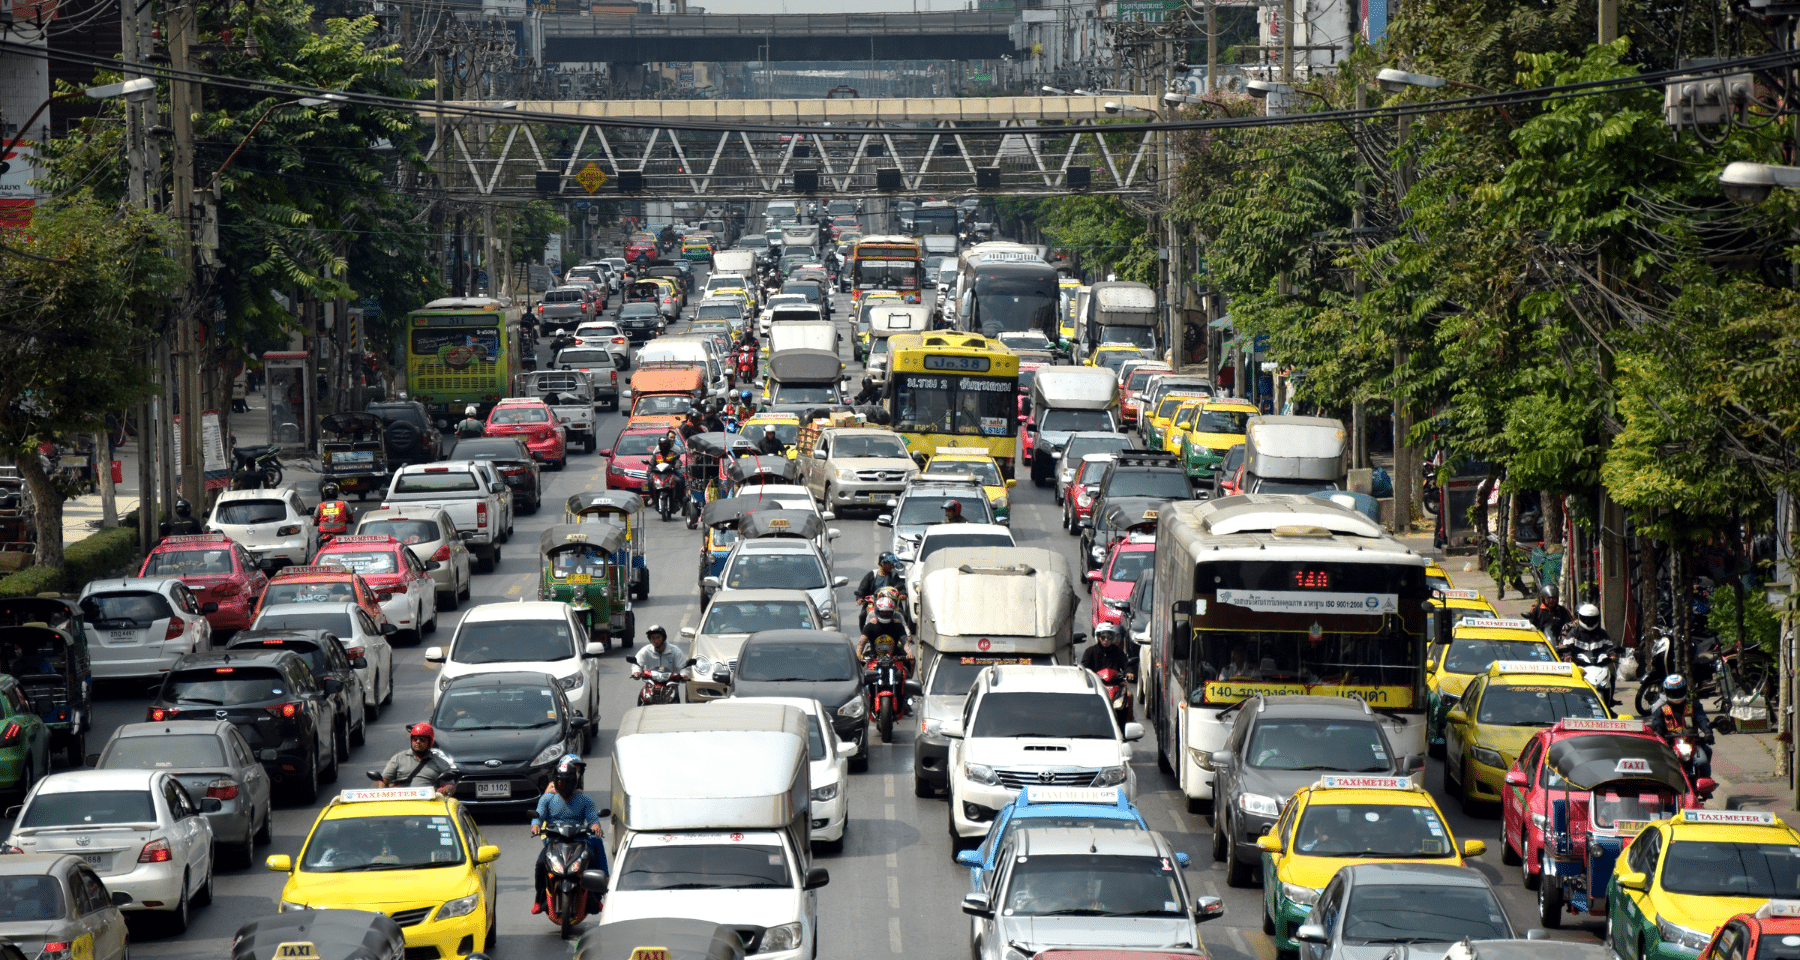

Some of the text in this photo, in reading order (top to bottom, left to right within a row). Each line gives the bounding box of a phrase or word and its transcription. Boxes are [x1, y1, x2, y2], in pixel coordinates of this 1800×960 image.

[1295, 571, 1327, 587] 140
[1211, 686, 1232, 698] 140
[1573, 721, 1627, 729] TAXI-METER
[1622, 761, 1645, 770] TAXI
[491, 783, 508, 792] 1102
[1337, 778, 1398, 788] TAXI-METER
[356, 790, 418, 799] TAXI-METER
[1699, 813, 1760, 822] TAXI-METER
[282, 945, 310, 956] TAXI
[636, 950, 666, 960] TAXI
